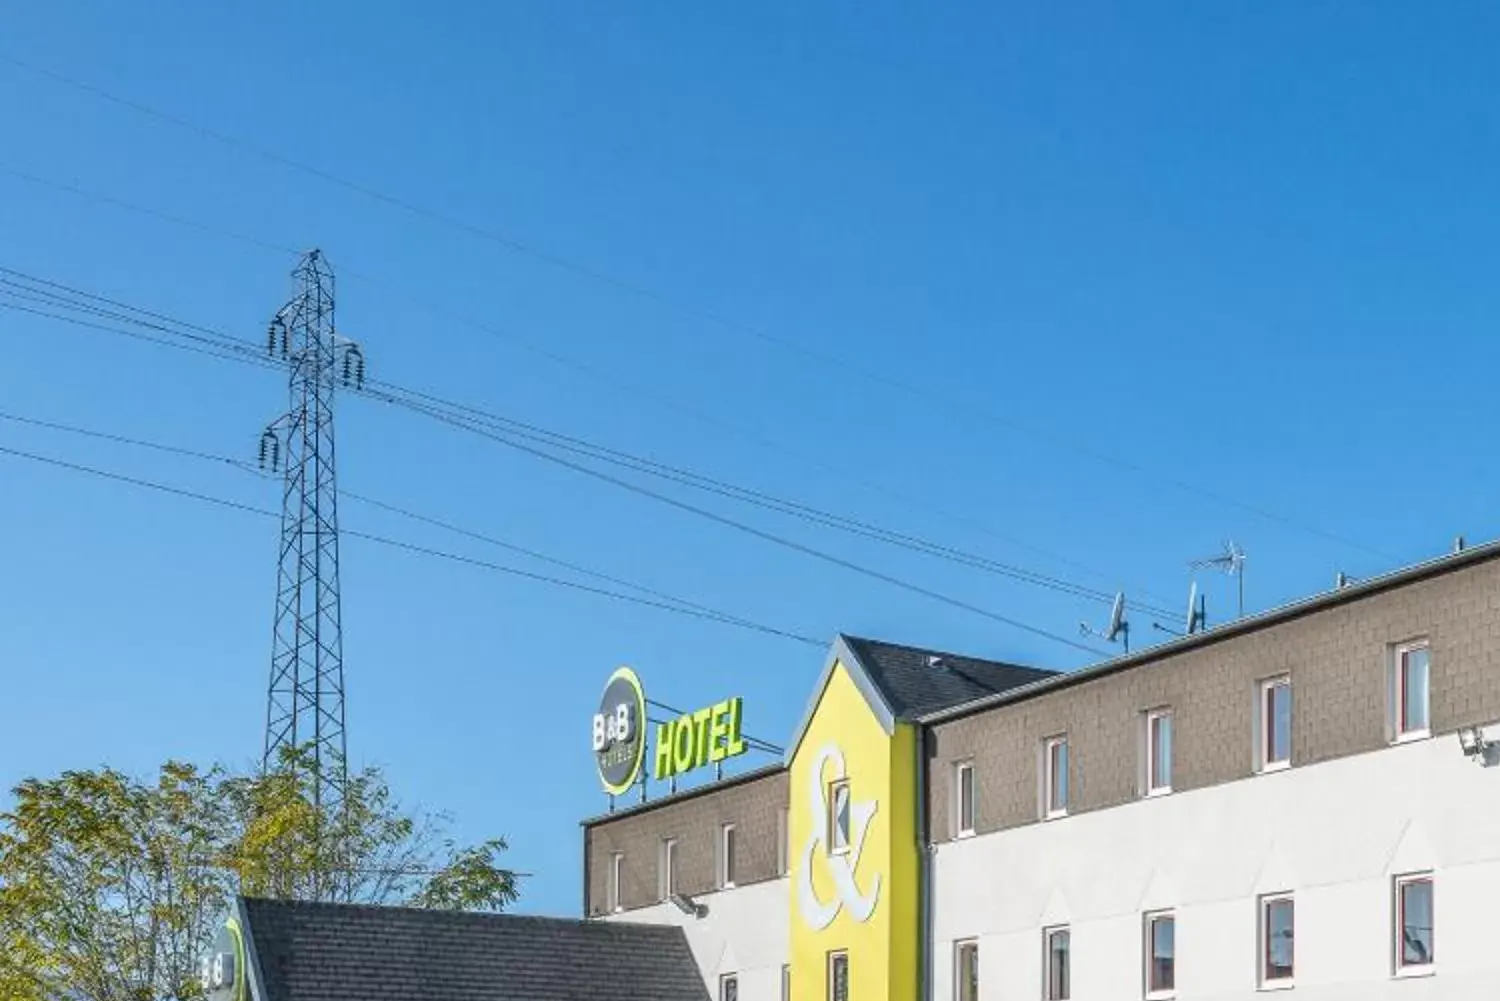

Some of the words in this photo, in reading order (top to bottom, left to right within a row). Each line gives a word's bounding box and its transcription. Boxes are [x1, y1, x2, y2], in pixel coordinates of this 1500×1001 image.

[592, 704, 633, 750] B&B
[656, 697, 746, 779] HOTEL
[799, 742, 880, 930] &
